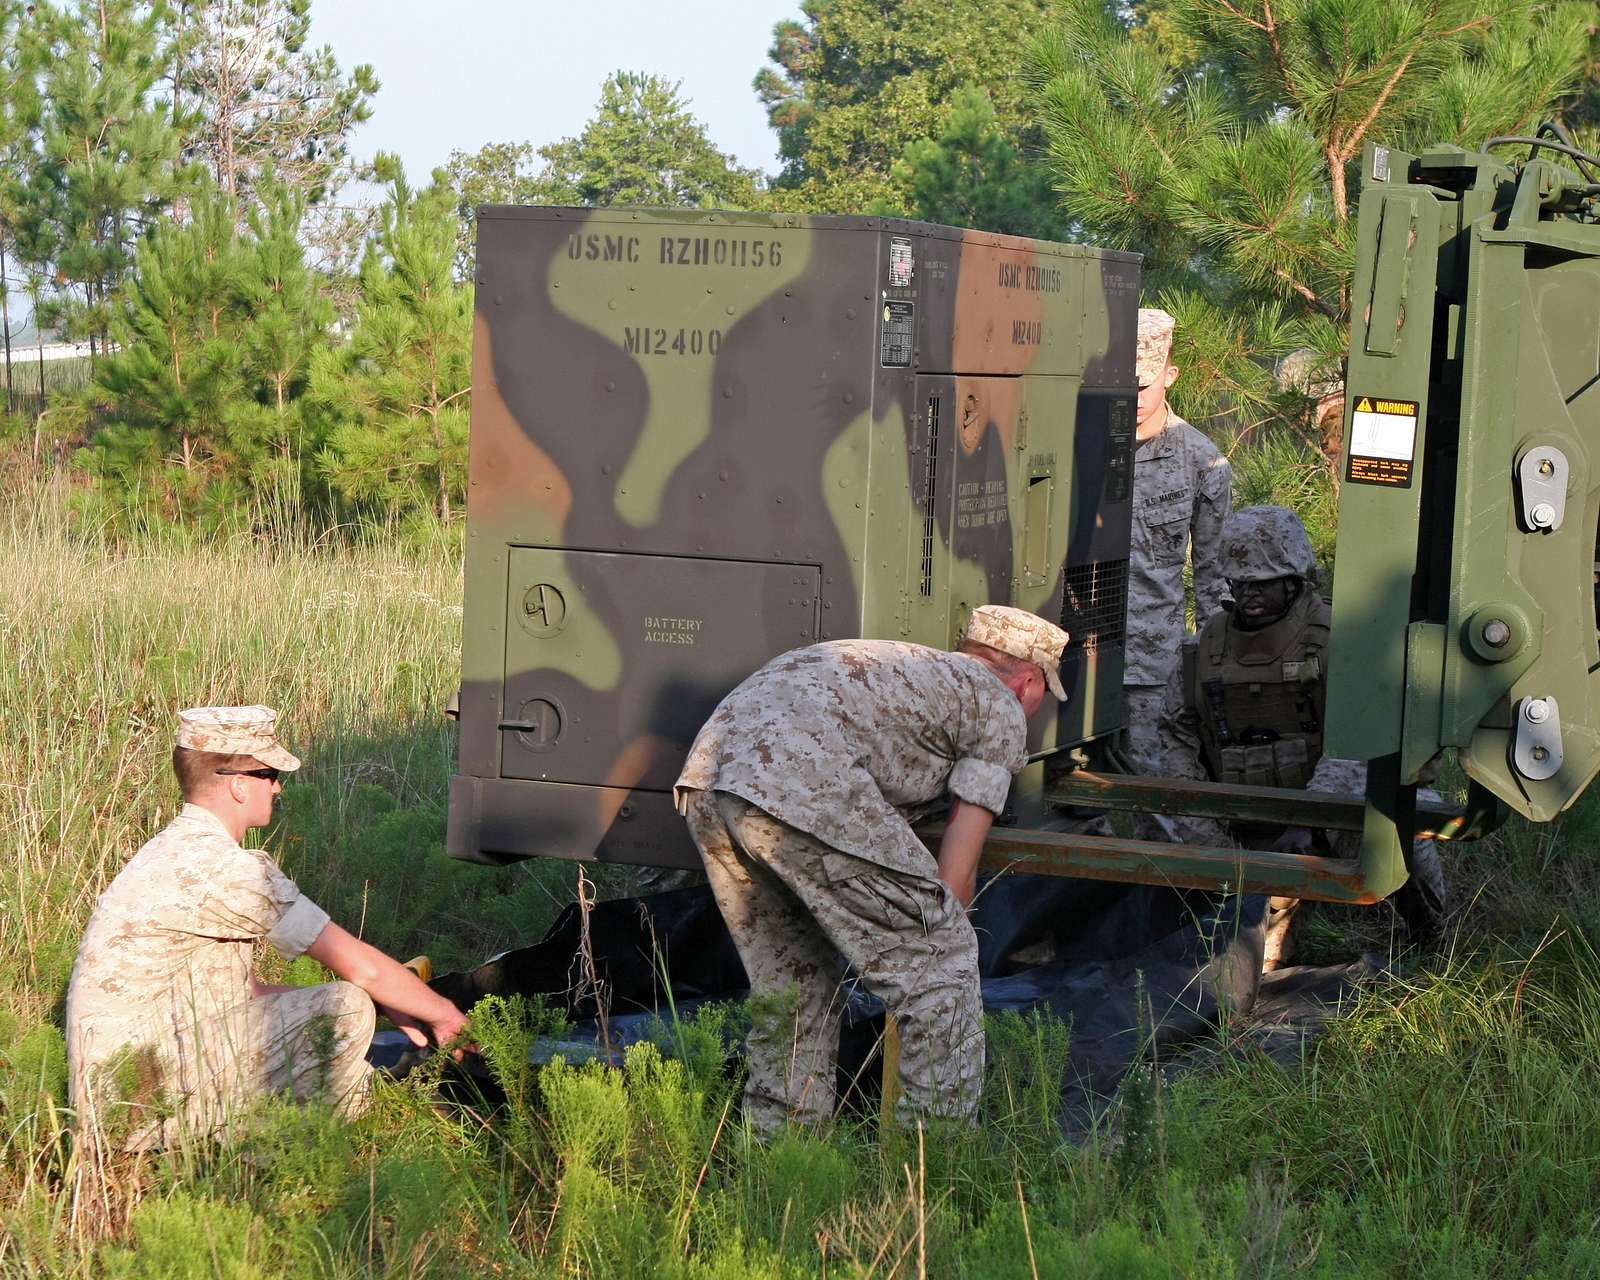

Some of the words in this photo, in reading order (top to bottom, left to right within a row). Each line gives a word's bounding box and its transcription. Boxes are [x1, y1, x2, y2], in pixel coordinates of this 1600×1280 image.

[568, 233, 640, 264] USMC
[659, 236, 782, 268] RZH01156
[998, 262, 1021, 288] USMC
[623, 327, 722, 355] M12400
[1376, 401, 1414, 415] WARNING
[1159, 490, 1186, 503] MARINES
[644, 616, 703, 631] BATTERY
[644, 631, 695, 645] ACCESS
